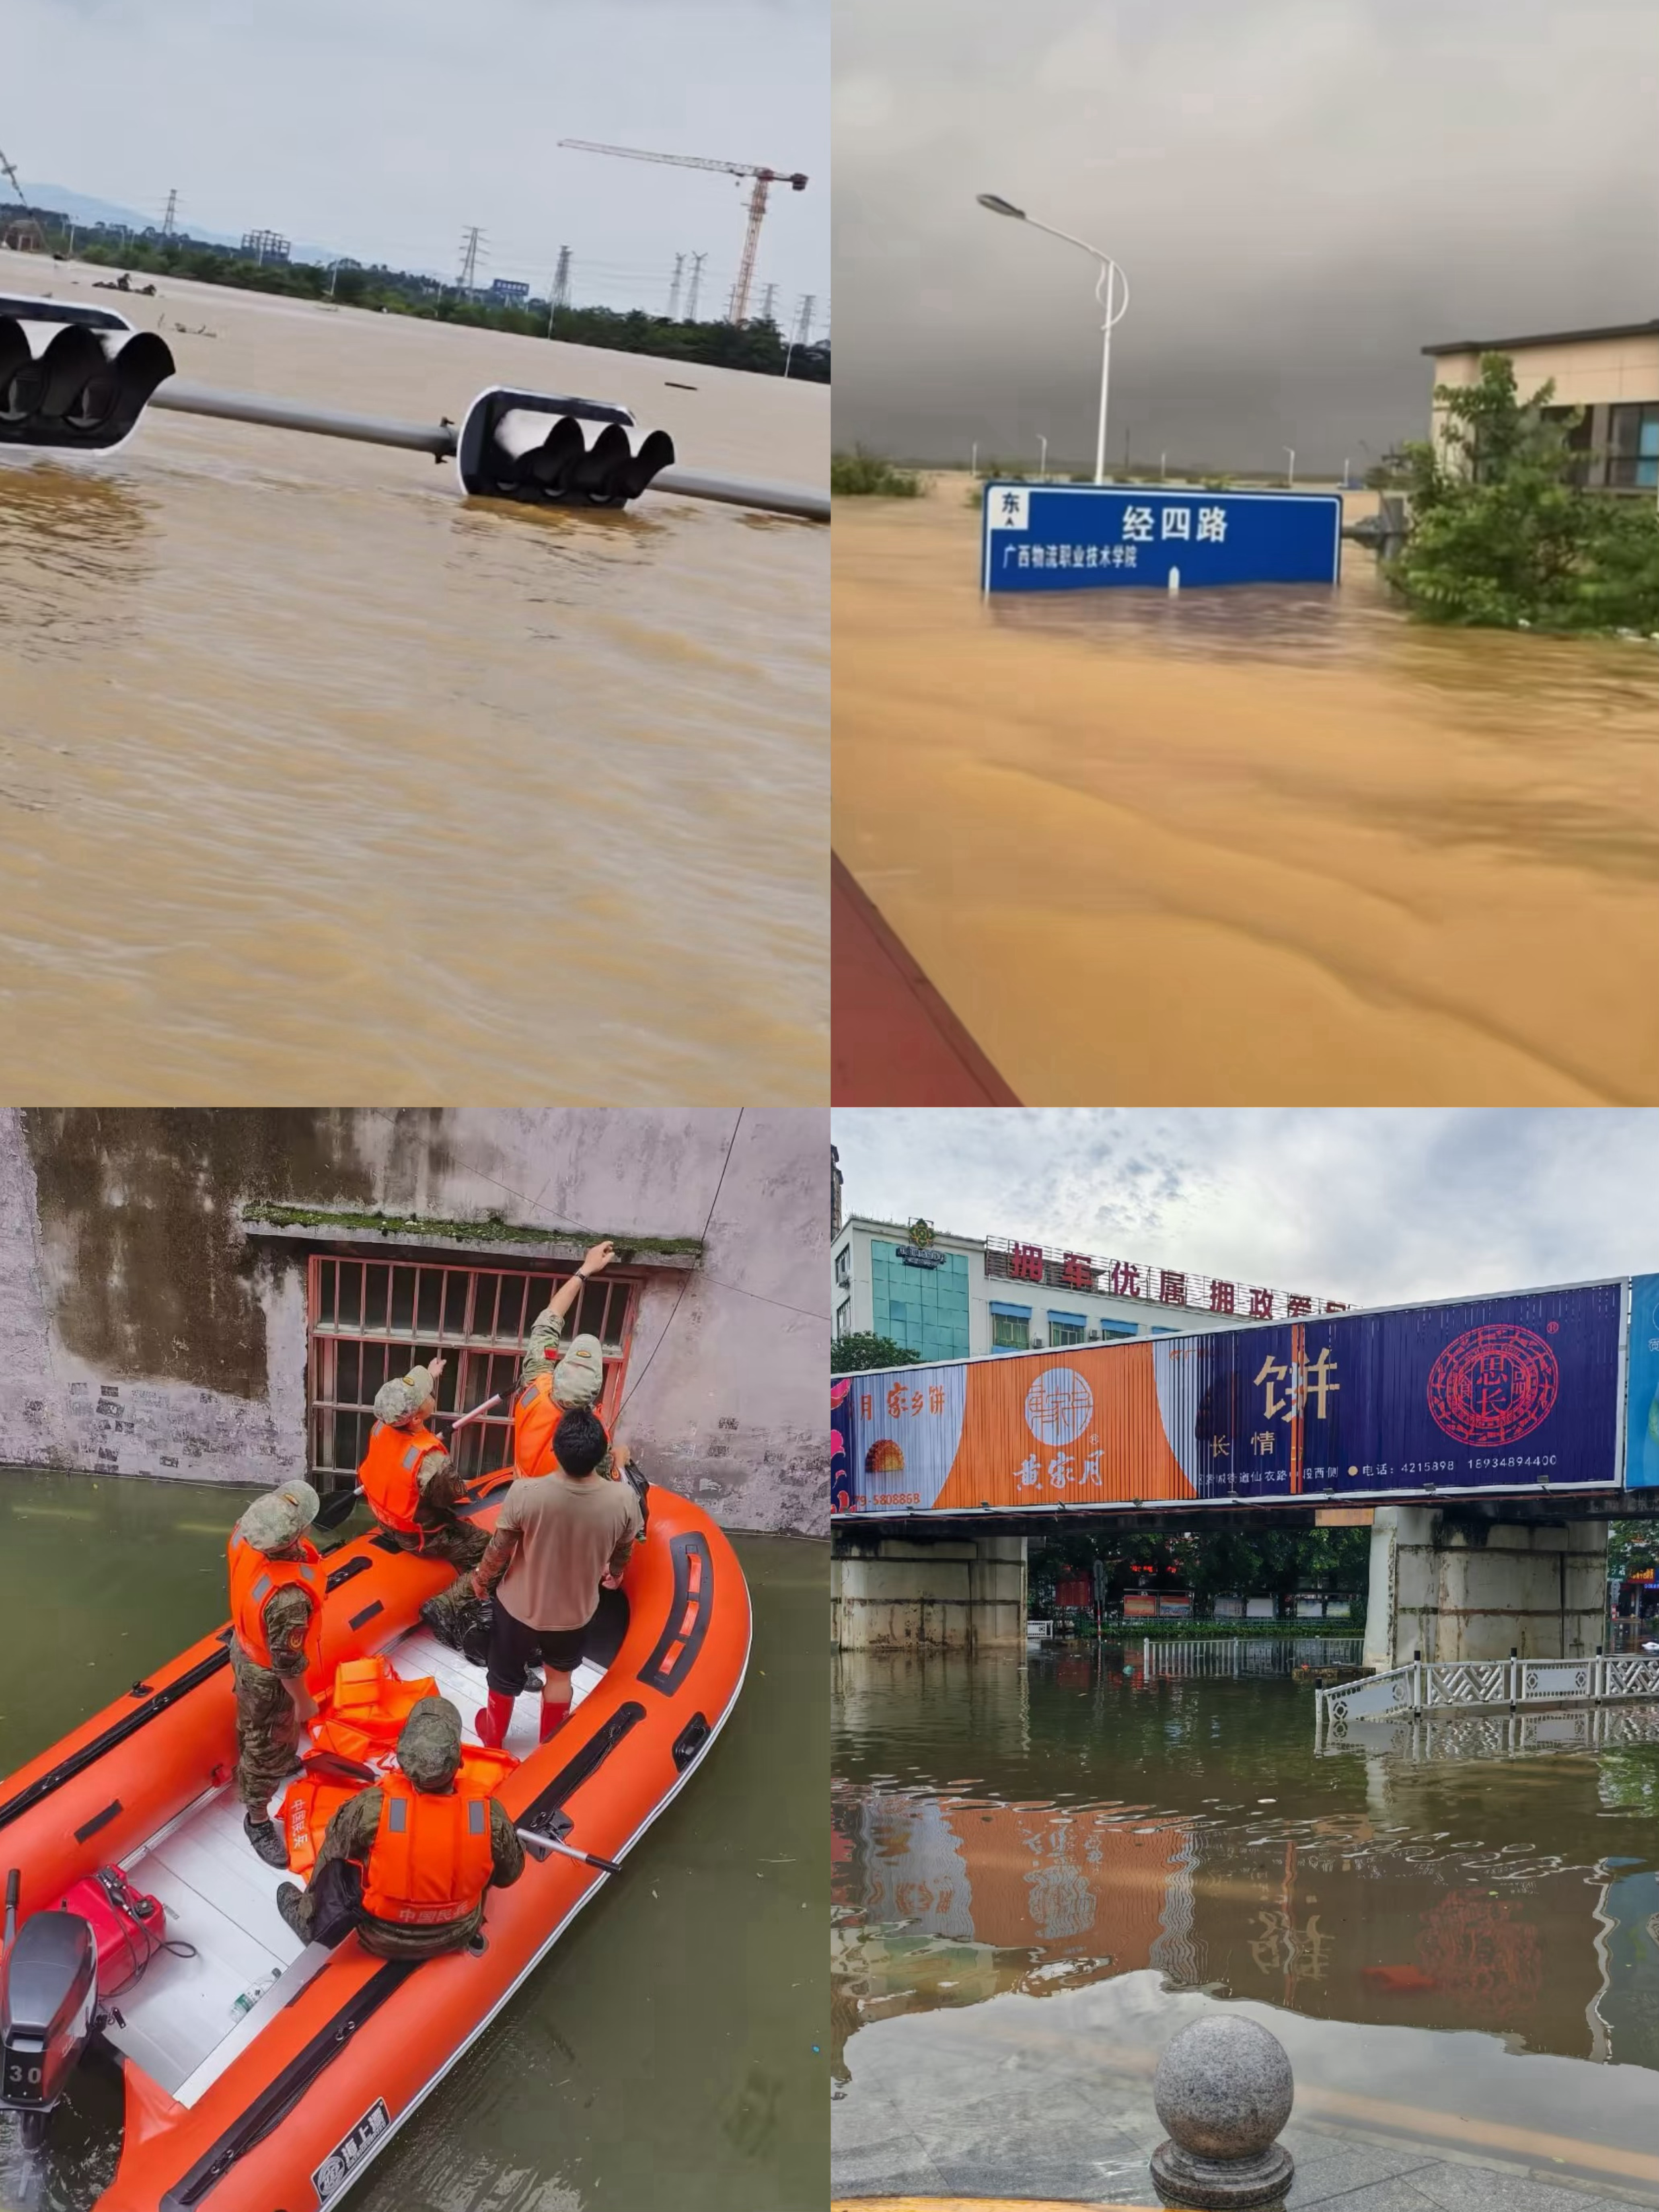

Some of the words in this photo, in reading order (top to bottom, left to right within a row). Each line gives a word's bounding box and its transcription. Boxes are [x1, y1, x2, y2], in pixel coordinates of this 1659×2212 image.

[1002, 492, 1020, 514] 东
[1122, 505, 1228, 543] 经四路
[1003, 543, 1137, 569] 广西物流职业技术学院
[10, 2065, 41, 2084] 30
